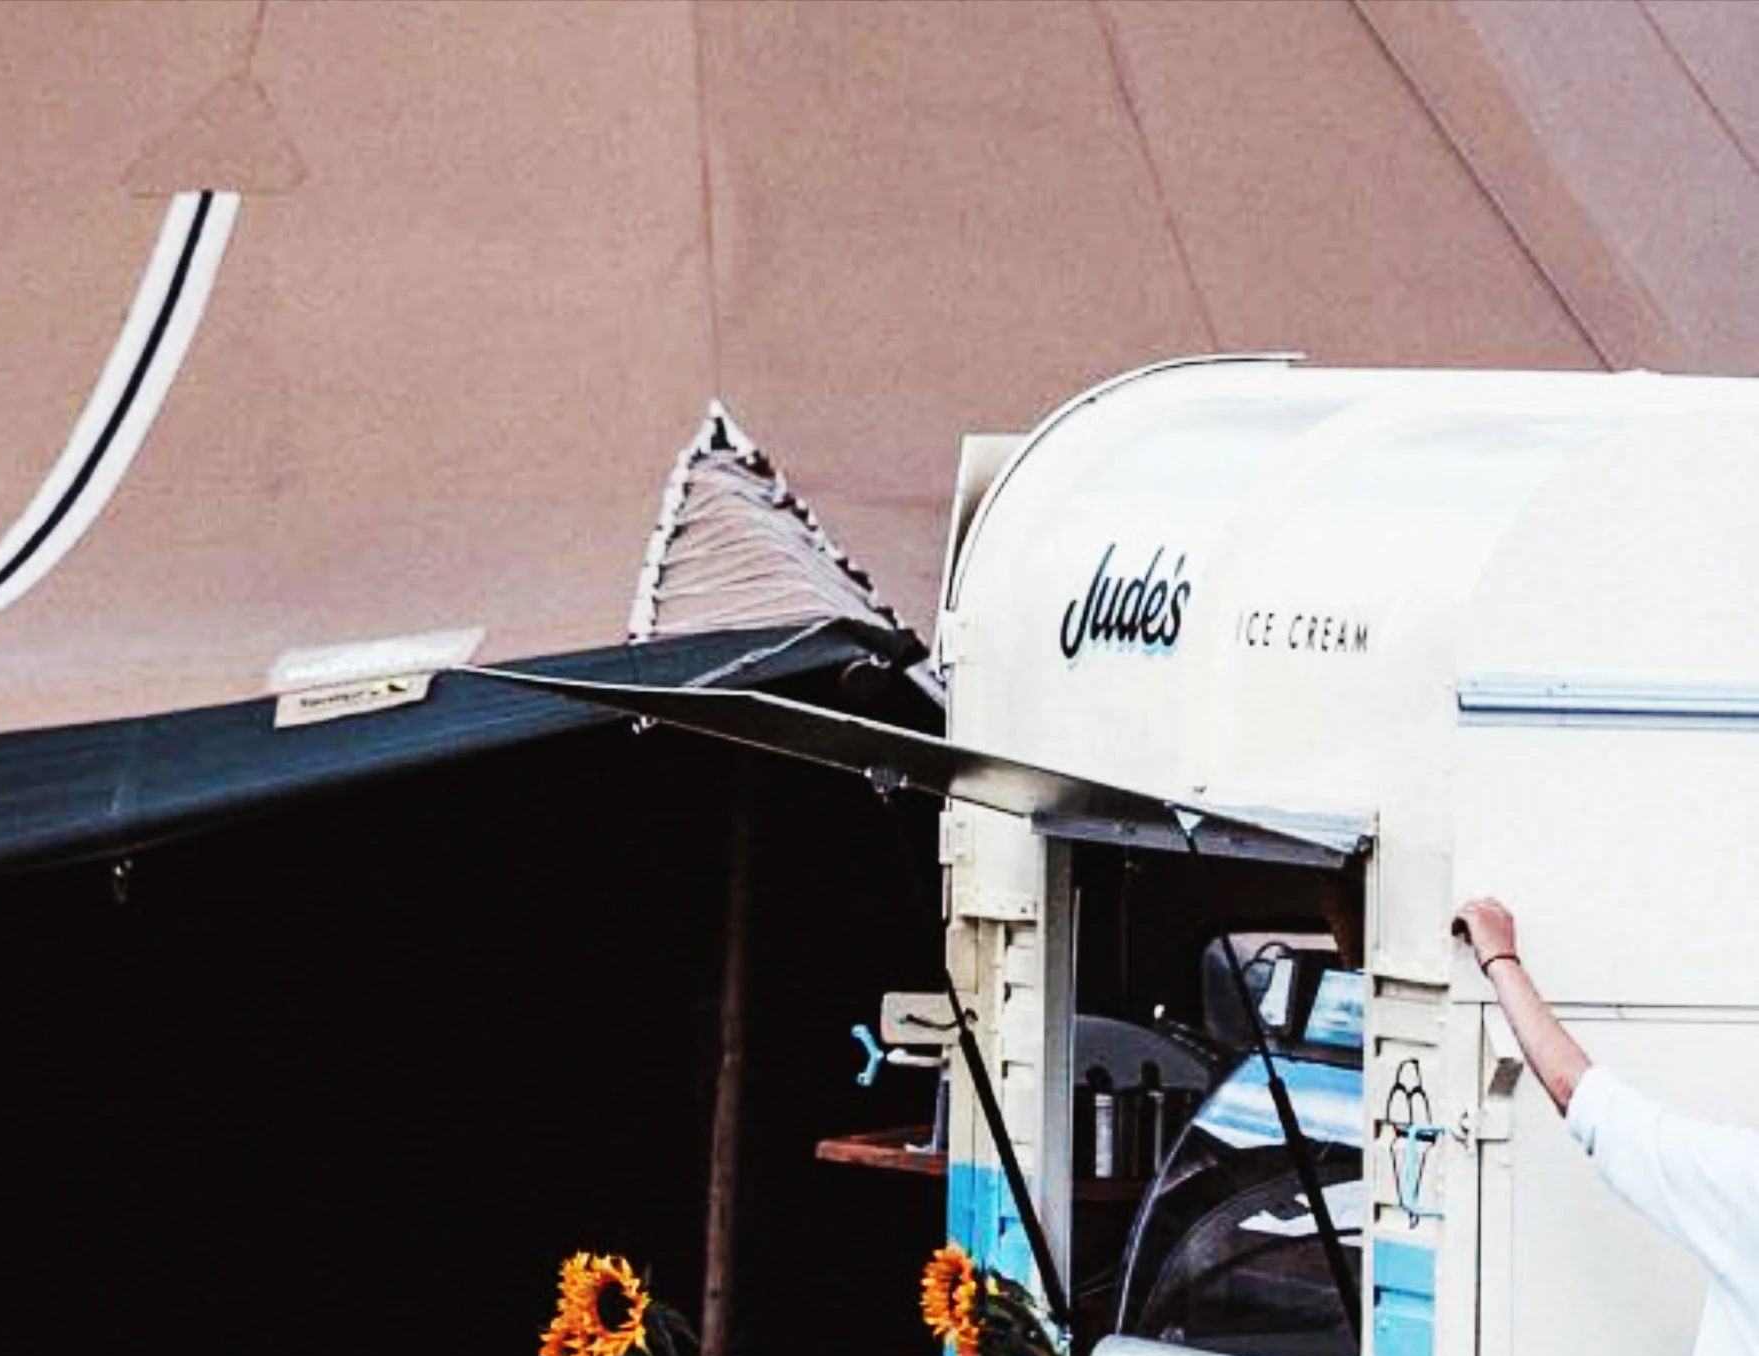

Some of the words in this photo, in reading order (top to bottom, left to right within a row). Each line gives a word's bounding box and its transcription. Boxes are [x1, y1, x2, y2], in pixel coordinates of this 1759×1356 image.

[1060, 542, 1191, 659] Jude's
[1237, 610, 1275, 647] ICE
[1288, 613, 1368, 653] CREAM
